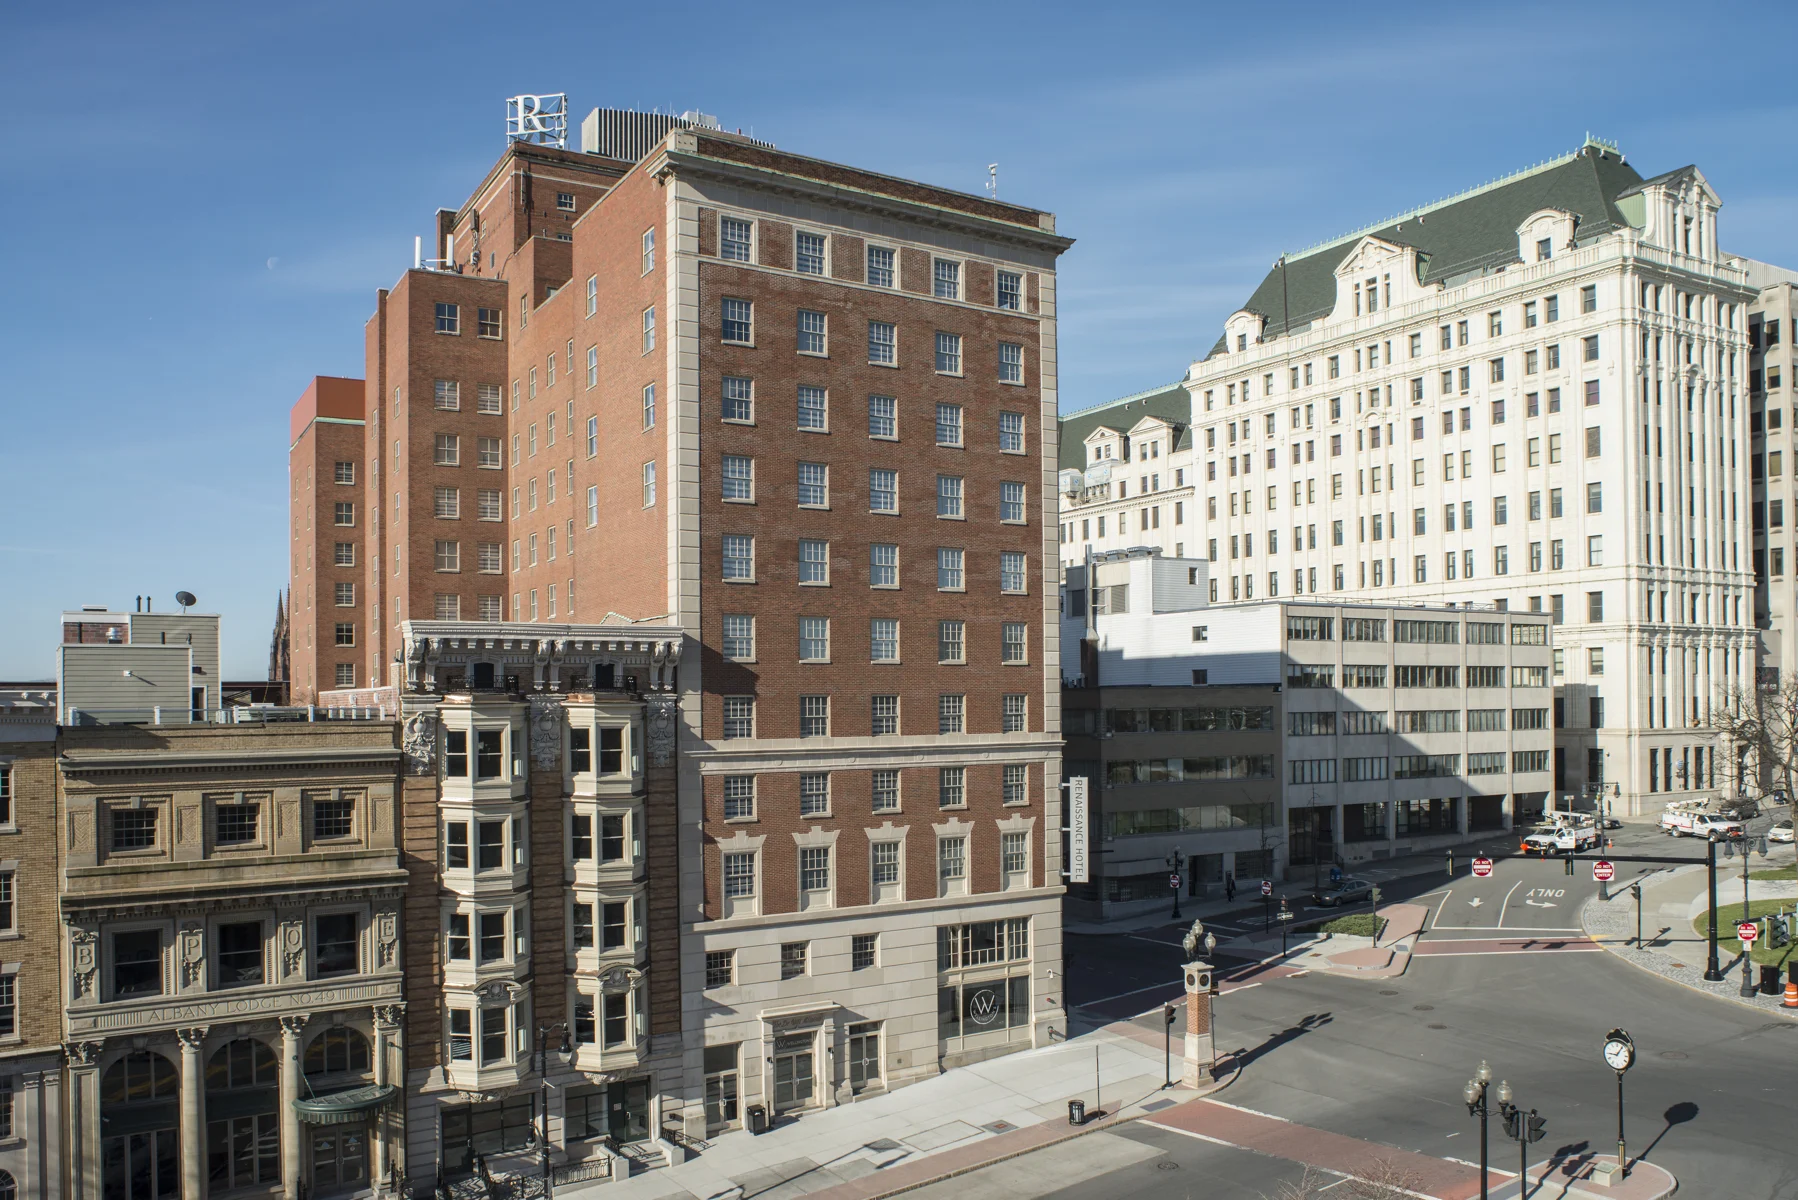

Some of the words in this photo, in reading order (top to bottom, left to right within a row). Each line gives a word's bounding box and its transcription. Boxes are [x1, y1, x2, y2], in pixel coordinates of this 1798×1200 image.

[514, 94, 555, 134] R
[1075, 779, 1083, 844] RENAISSANCE
[1075, 848, 1084, 879] HOTEL
[1526, 889, 1565, 897] ONLY
[79, 947, 92, 965] B
[186, 938, 199, 955] P
[288, 929, 300, 945] O
[382, 920, 394, 937] E
[149, 1003, 219, 1022] ALBANY
[226, 996, 282, 1013] LODGE
[975, 994, 995, 1015] W
